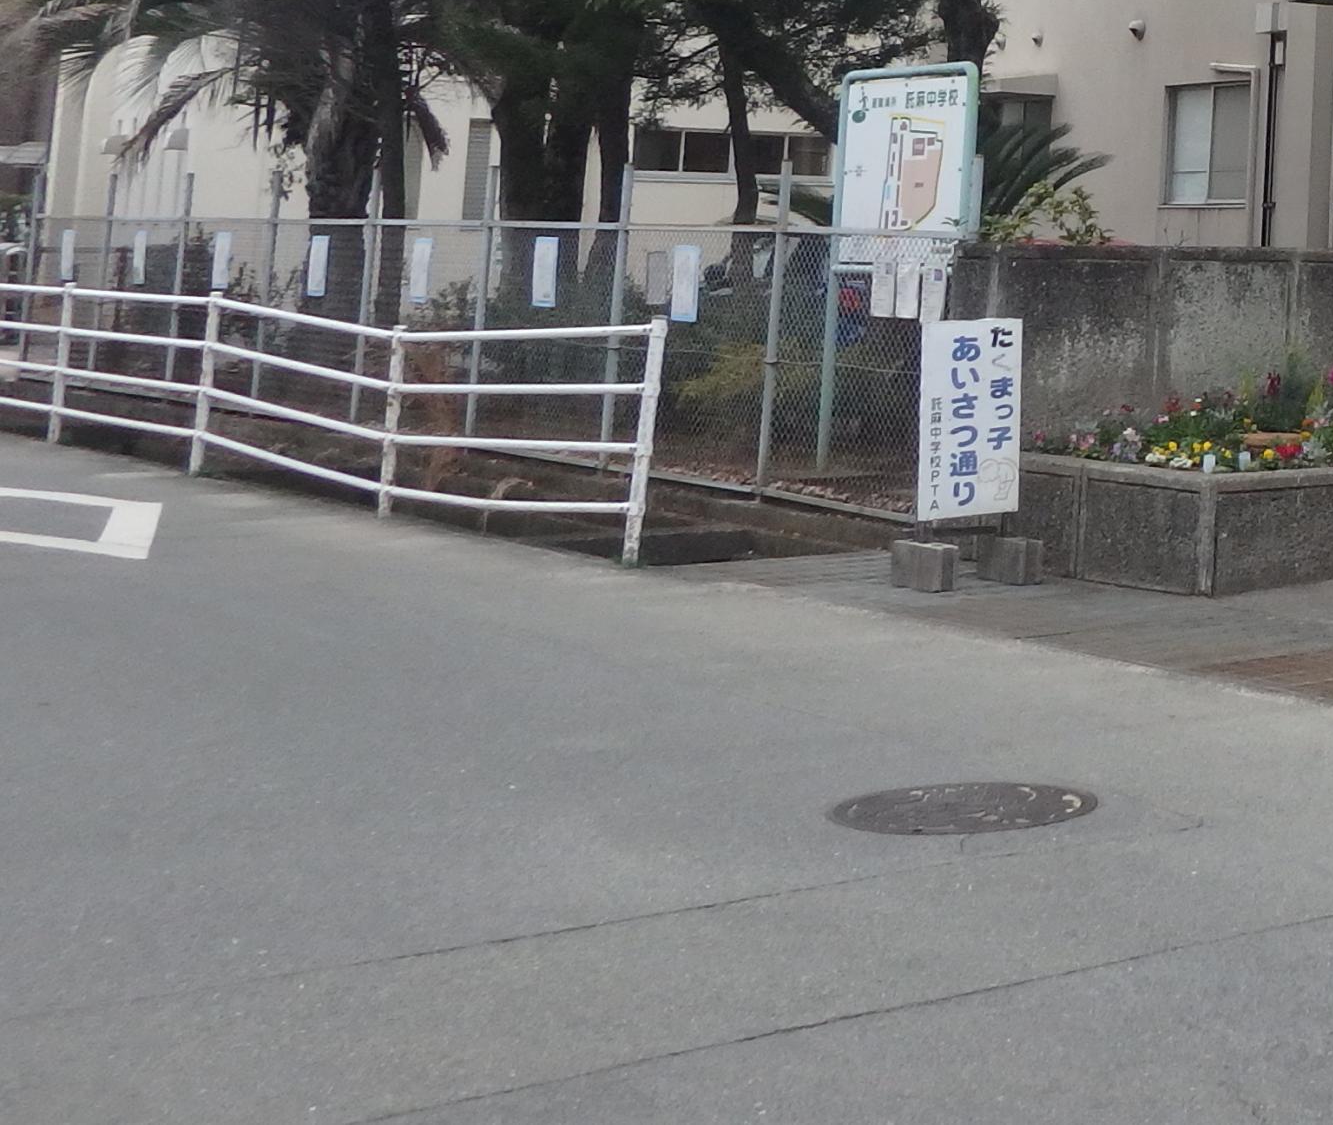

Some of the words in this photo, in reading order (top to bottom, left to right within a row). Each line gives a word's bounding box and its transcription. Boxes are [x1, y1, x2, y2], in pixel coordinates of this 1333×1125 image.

[949, 334, 981, 507] あいさつ通り
